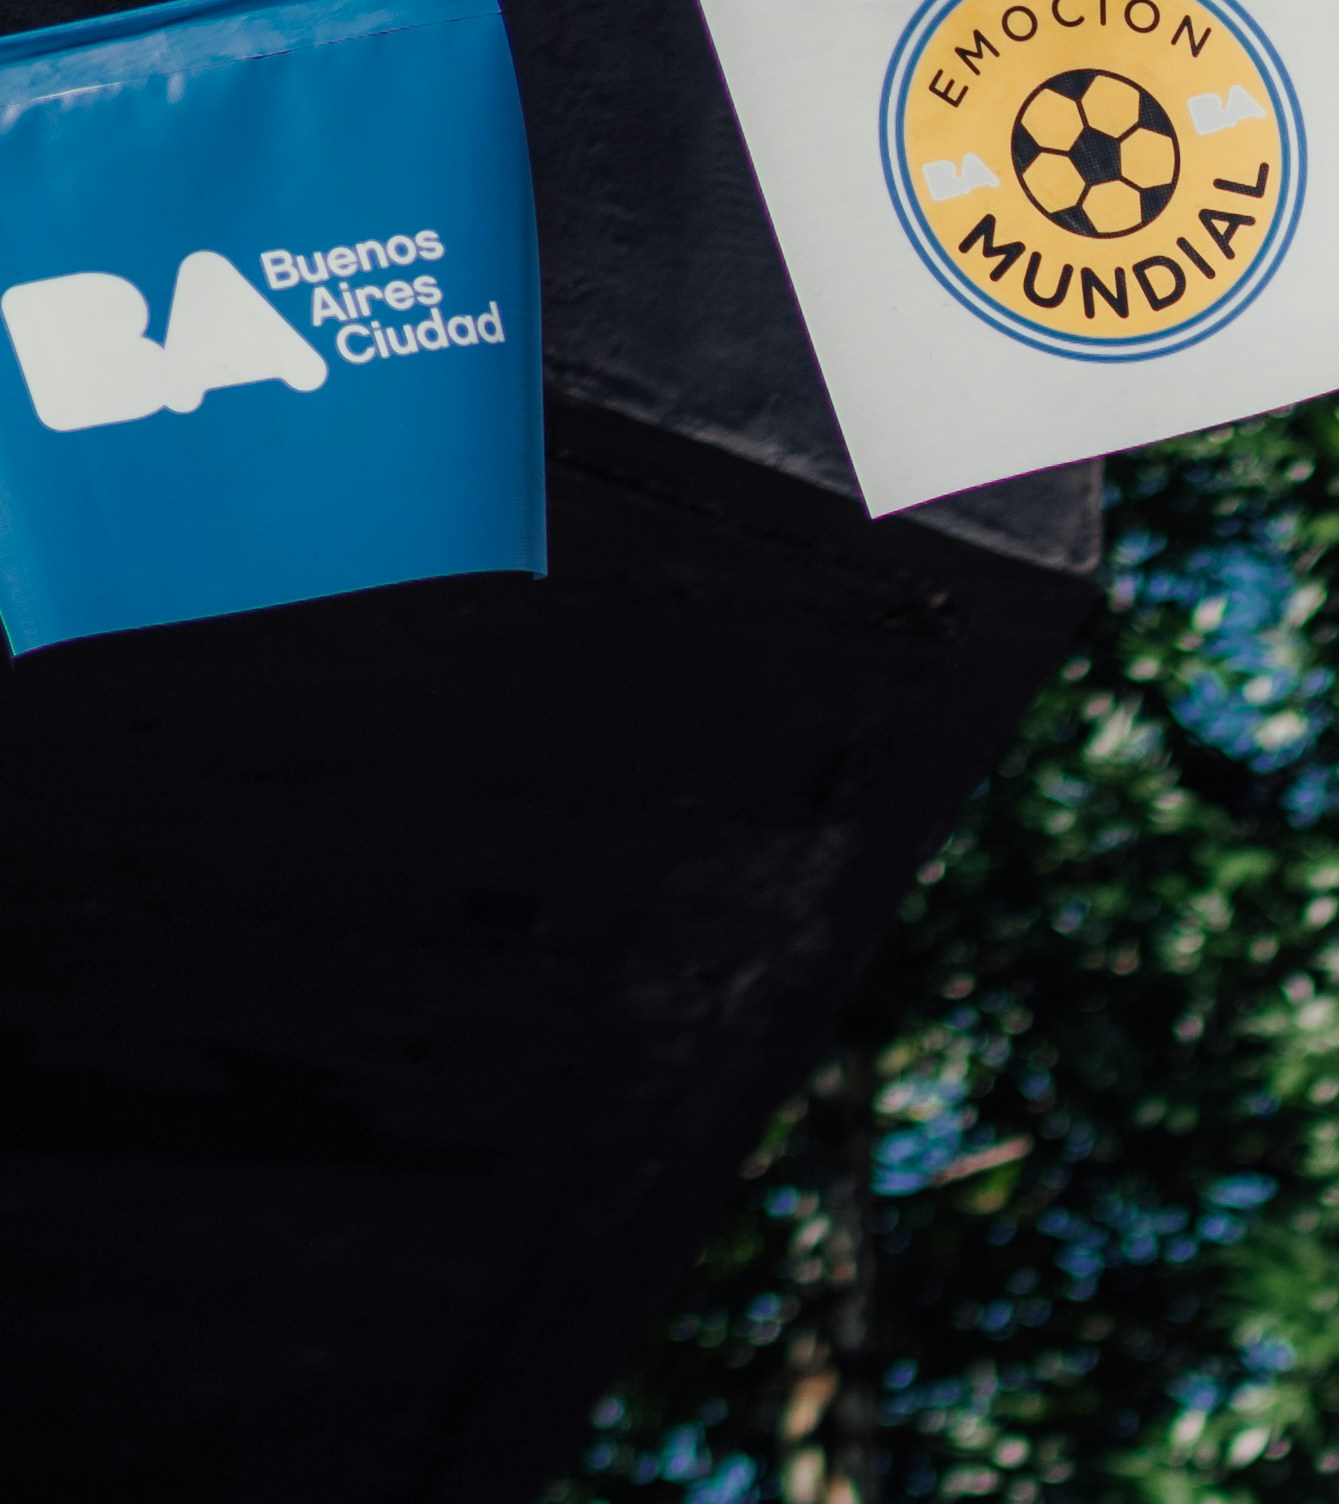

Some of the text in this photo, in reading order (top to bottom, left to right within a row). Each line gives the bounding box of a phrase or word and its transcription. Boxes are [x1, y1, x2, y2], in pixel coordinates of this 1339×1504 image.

[260, 229, 446, 291] Buenos
[958, 162, 1270, 319] MUNDIAL
[311, 275, 443, 327] Aires
[336, 301, 506, 364] Ciudad
[1, 251, 328, 432] BA
